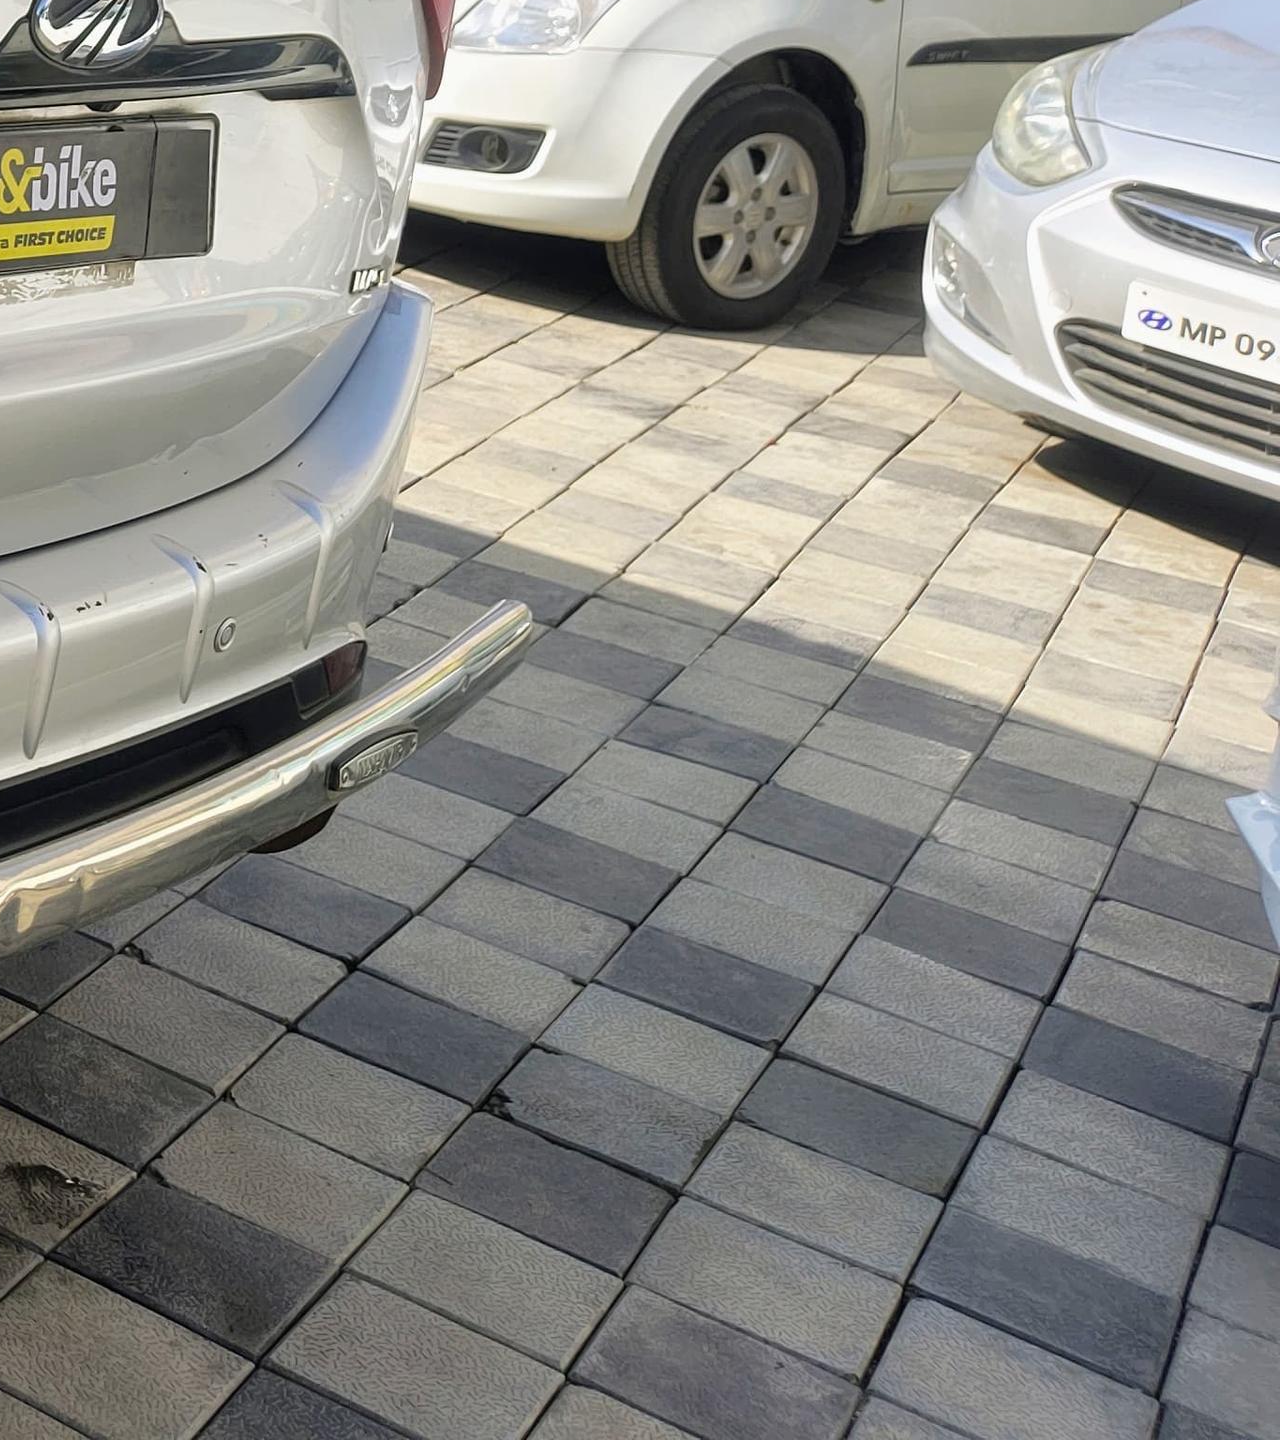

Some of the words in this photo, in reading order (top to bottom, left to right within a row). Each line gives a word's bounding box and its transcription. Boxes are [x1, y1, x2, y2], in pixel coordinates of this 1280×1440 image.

[13, 231, 56, 249] FIRST
[56, 226, 107, 245] CHOICE
[1180, 317, 1226, 347] MP
[1235, 333, 1275, 361] 09
